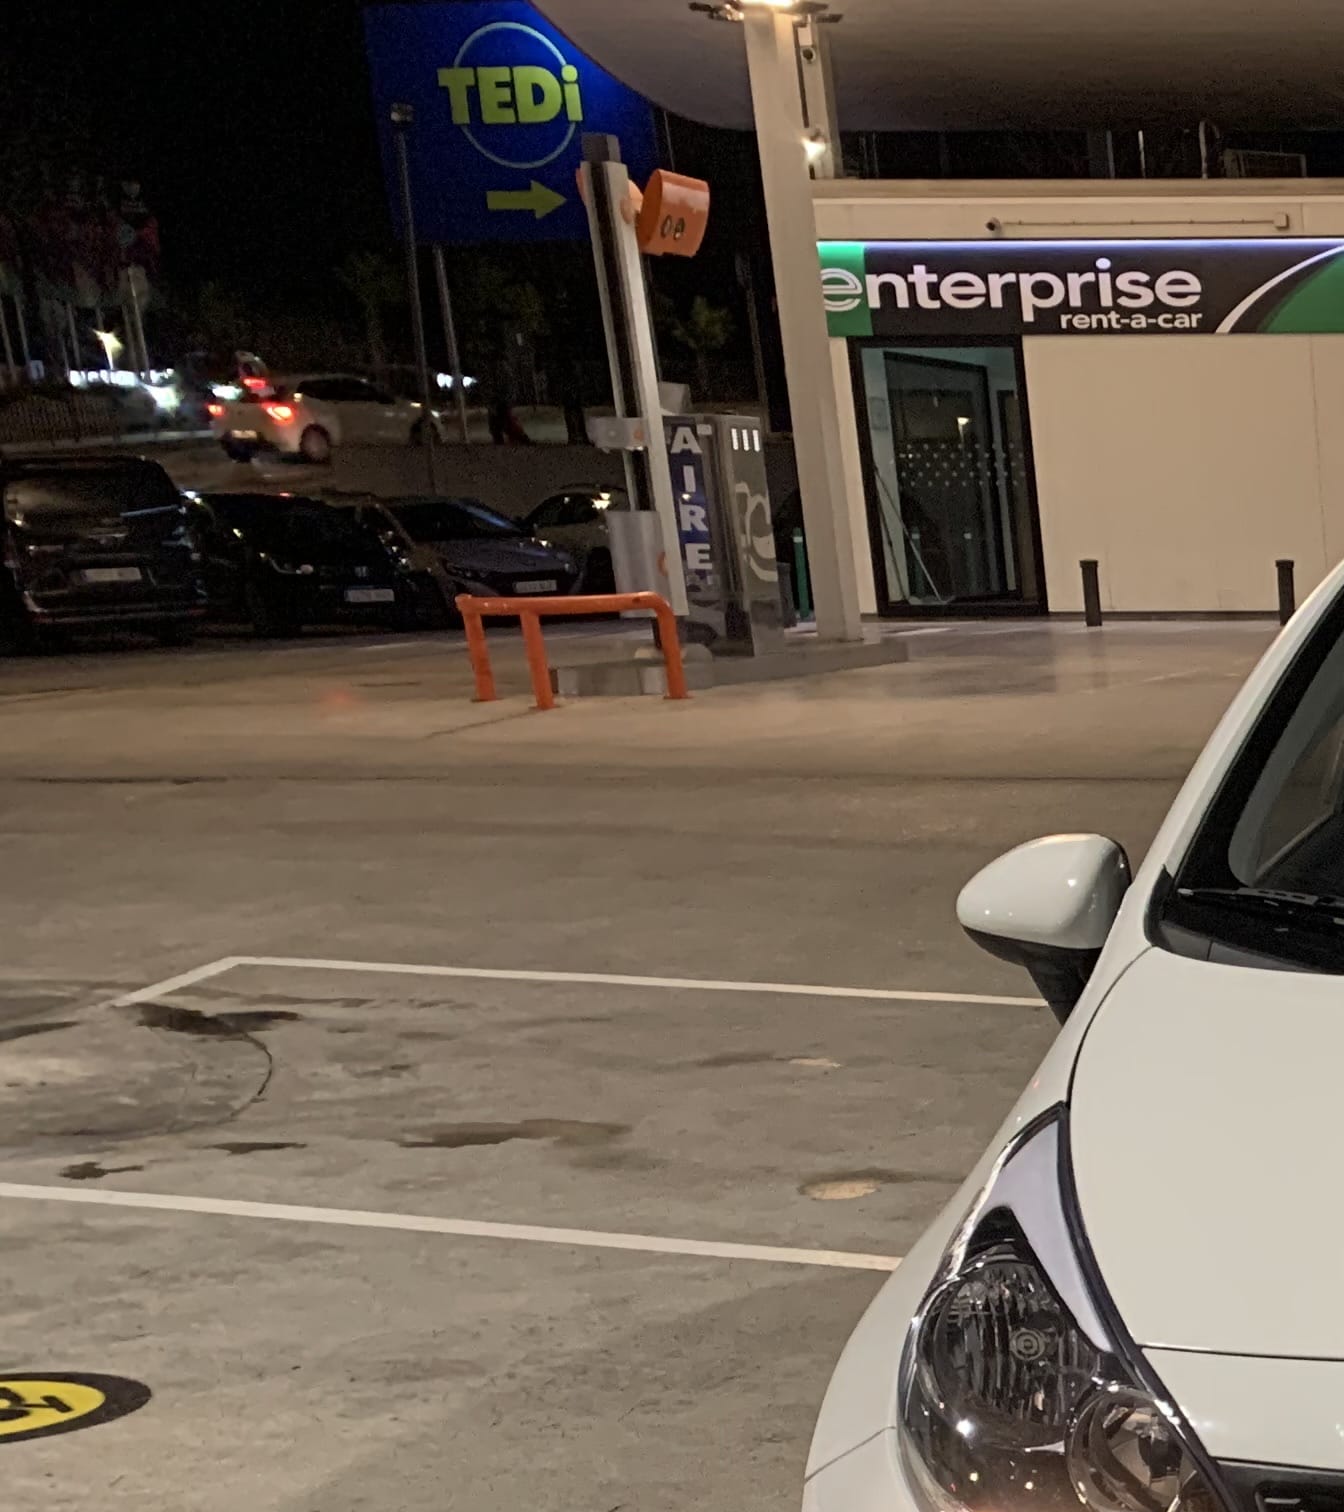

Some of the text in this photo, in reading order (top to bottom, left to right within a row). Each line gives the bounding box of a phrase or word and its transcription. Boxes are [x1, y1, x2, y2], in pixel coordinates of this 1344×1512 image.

[437, 65, 584, 125] TEDi
[820, 257, 1203, 323] enterprise
[1060, 311, 1203, 330] rent-a-car
[670, 426, 713, 571] AIRE
